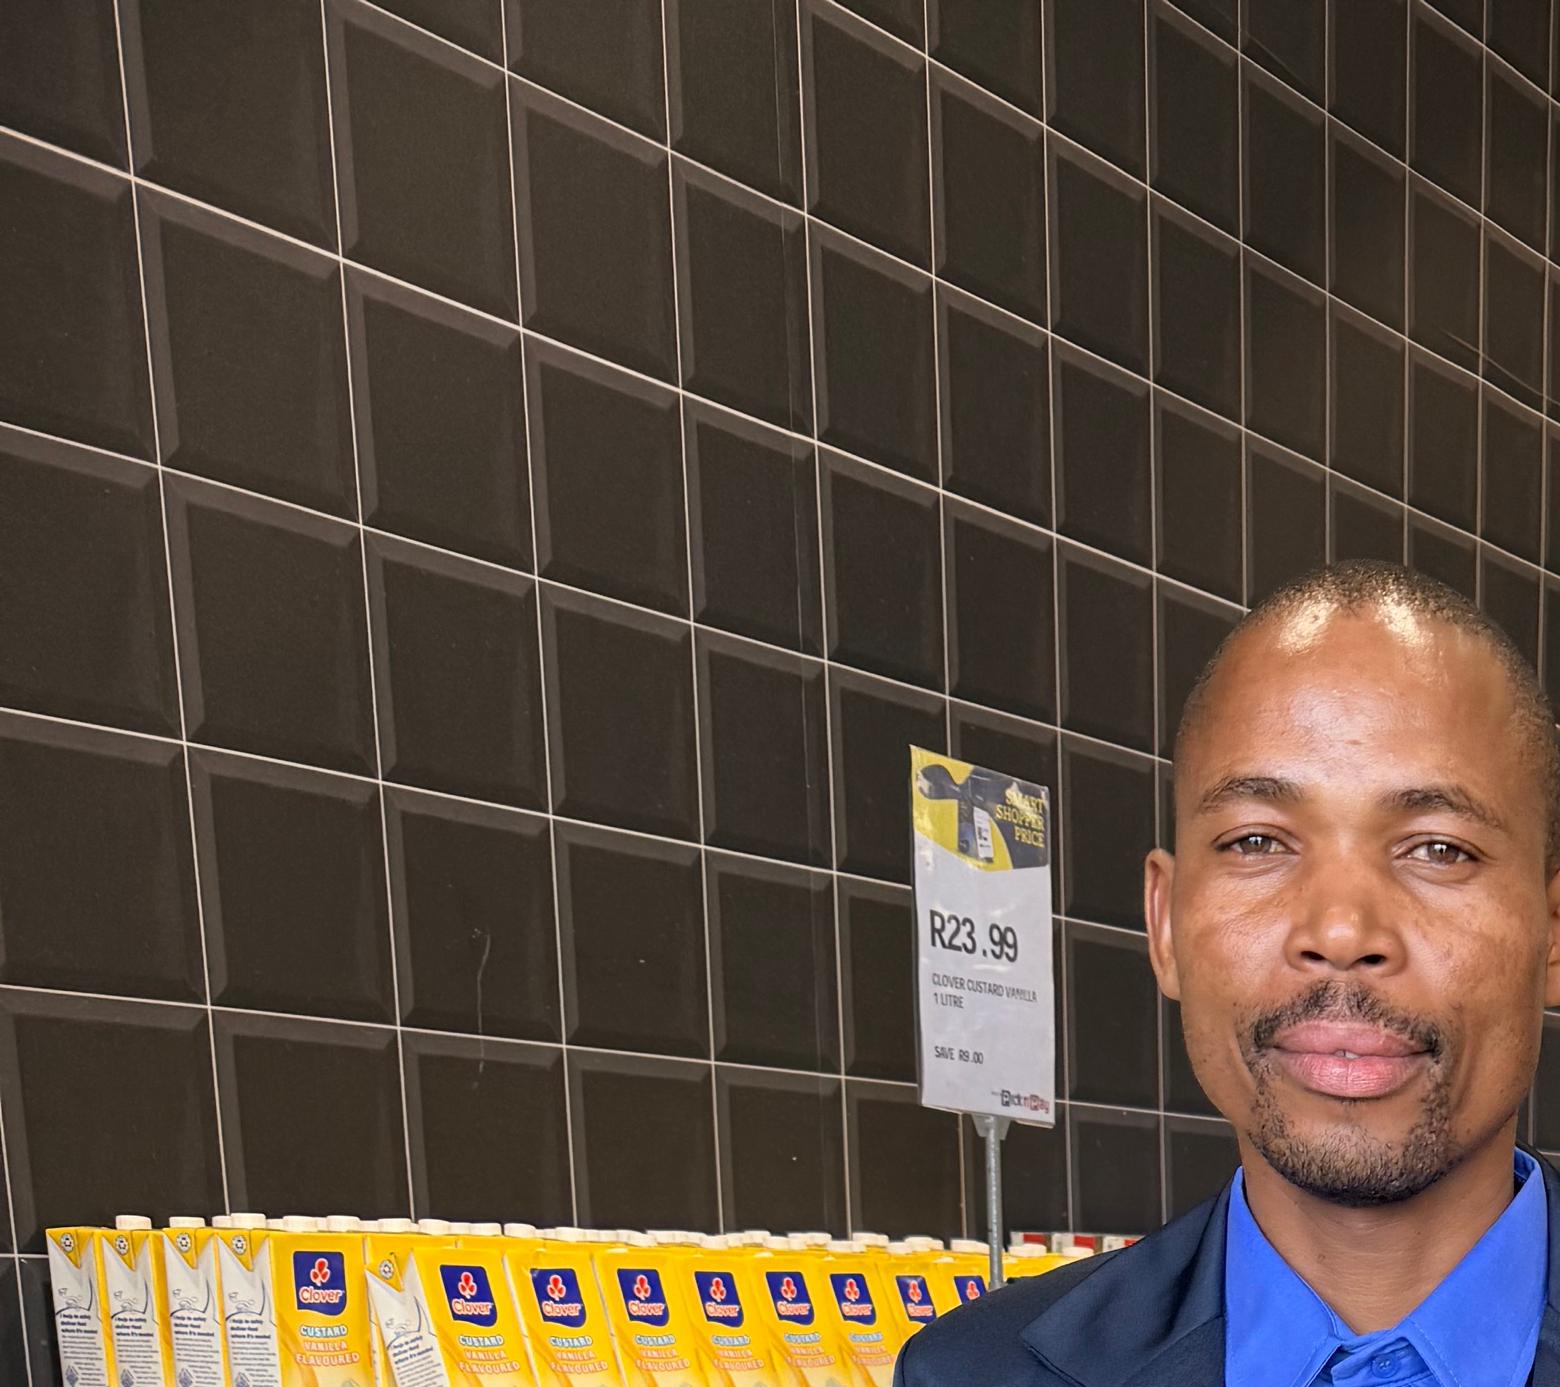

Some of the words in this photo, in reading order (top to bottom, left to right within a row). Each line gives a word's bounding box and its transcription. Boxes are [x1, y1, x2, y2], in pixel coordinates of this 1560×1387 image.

[1014, 825, 1045, 848] PRICE
[929, 909, 1018, 963] R23.99
[932, 972, 966, 991] CLOVER
[966, 978, 1005, 998] CUSTARD
[1005, 986, 1038, 1003] VANILLA
[940, 993, 964, 1009] LITRE
[934, 1045, 955, 1060] SAVE
[299, 1286, 342, 1304] Clover
[452, 1299, 491, 1316] Clover
[542, 1300, 581, 1316] Clover
[300, 1325, 348, 1337] CUSTARD
[303, 1341, 347, 1353] VANILLA
[459, 1335, 504, 1347] CUSTARD
[549, 1335, 593, 1347] CUSTARD
[465, 1350, 507, 1361] VANILLA
[557, 1350, 595, 1361] VANILLA
